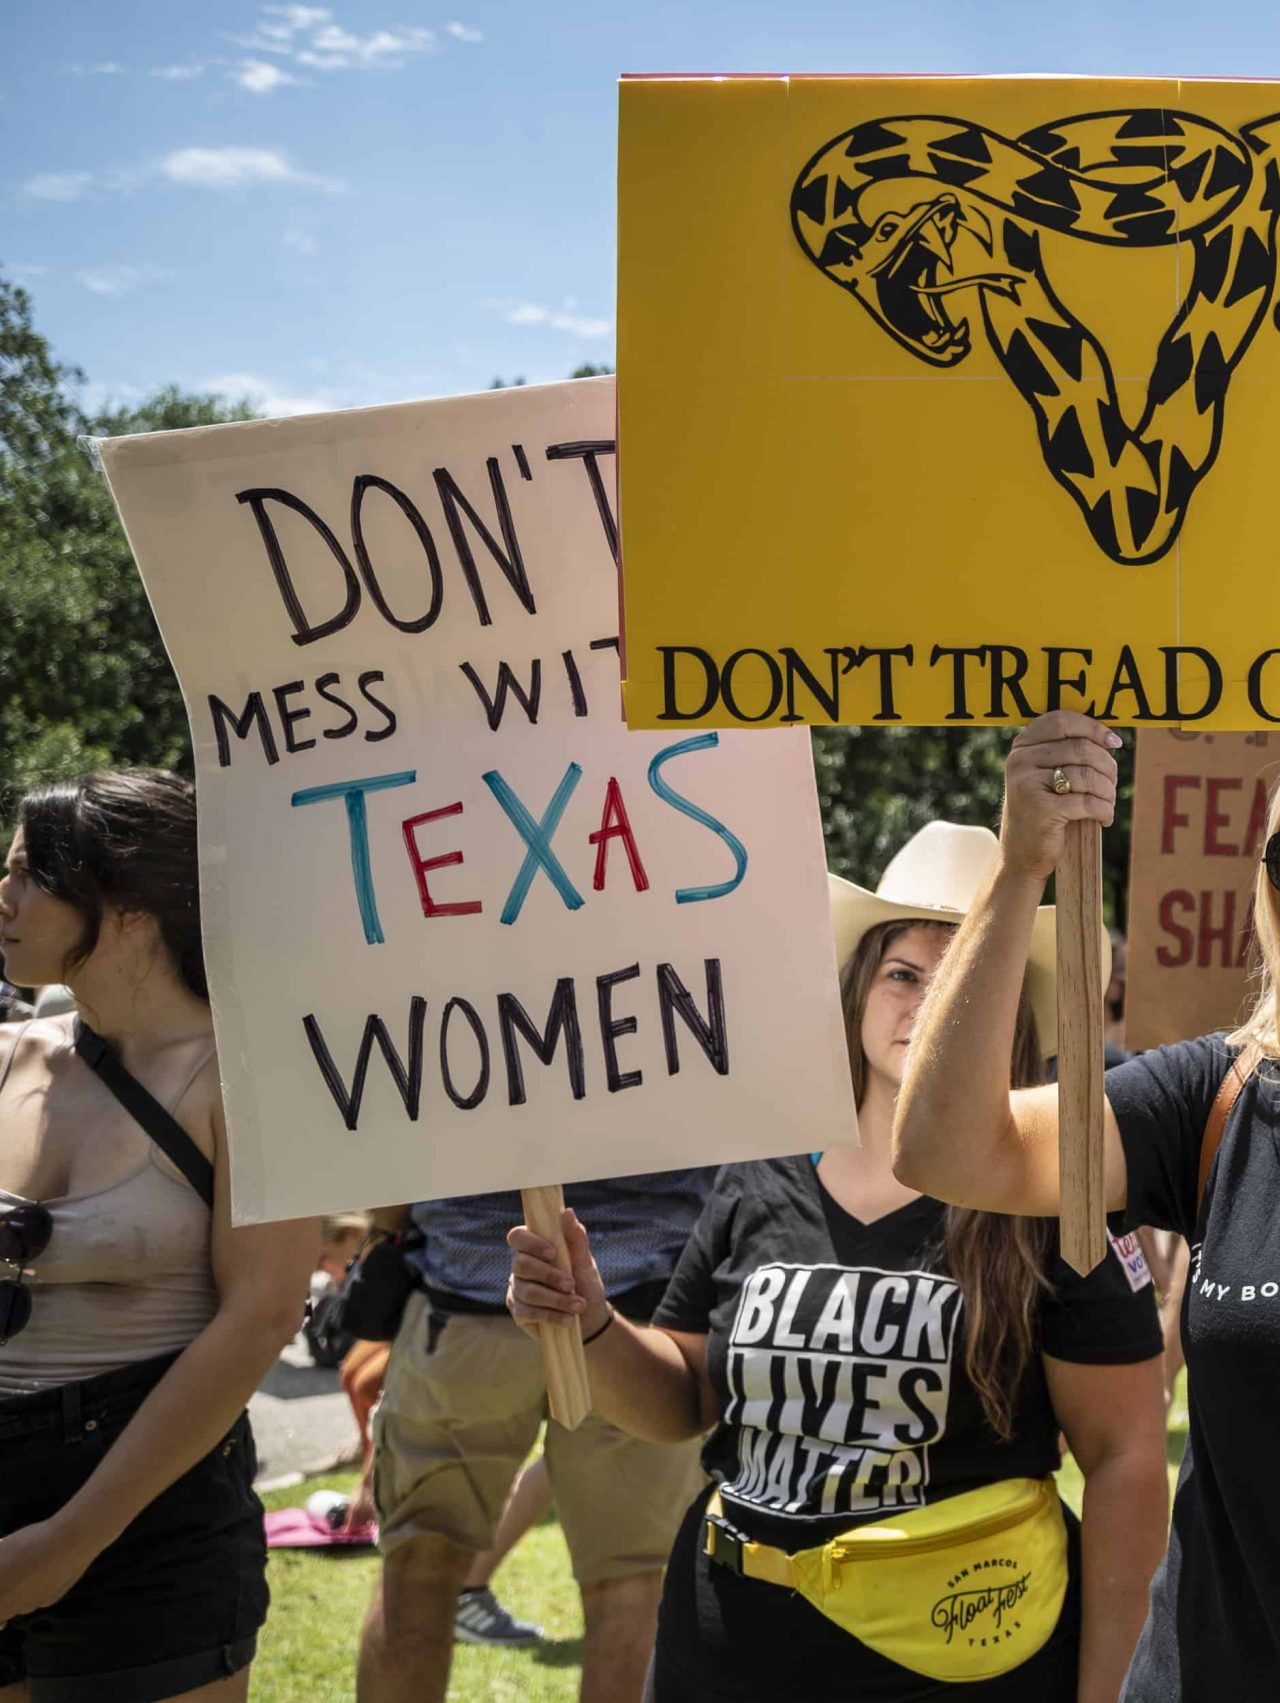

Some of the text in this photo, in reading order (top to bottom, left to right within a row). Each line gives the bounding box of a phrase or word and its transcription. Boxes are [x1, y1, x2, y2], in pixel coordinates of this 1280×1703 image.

[235, 439, 617, 645] DON'T
[207, 636, 620, 768] MESS WI
[656, 645, 914, 724] DON'T
[930, 644, 1223, 722] TREAD
[290, 731, 749, 945] TEXAS
[302, 957, 730, 1130] WOMEN
[733, 1267, 959, 1361] BLACK
[1200, 1278, 1231, 1301] MY
[730, 1351, 943, 1446] LIVES
[723, 1427, 922, 1514] MATTER
[947, 1558, 1018, 1588] SAN MARCOS
[968, 1620, 1021, 1647] TEXAS
